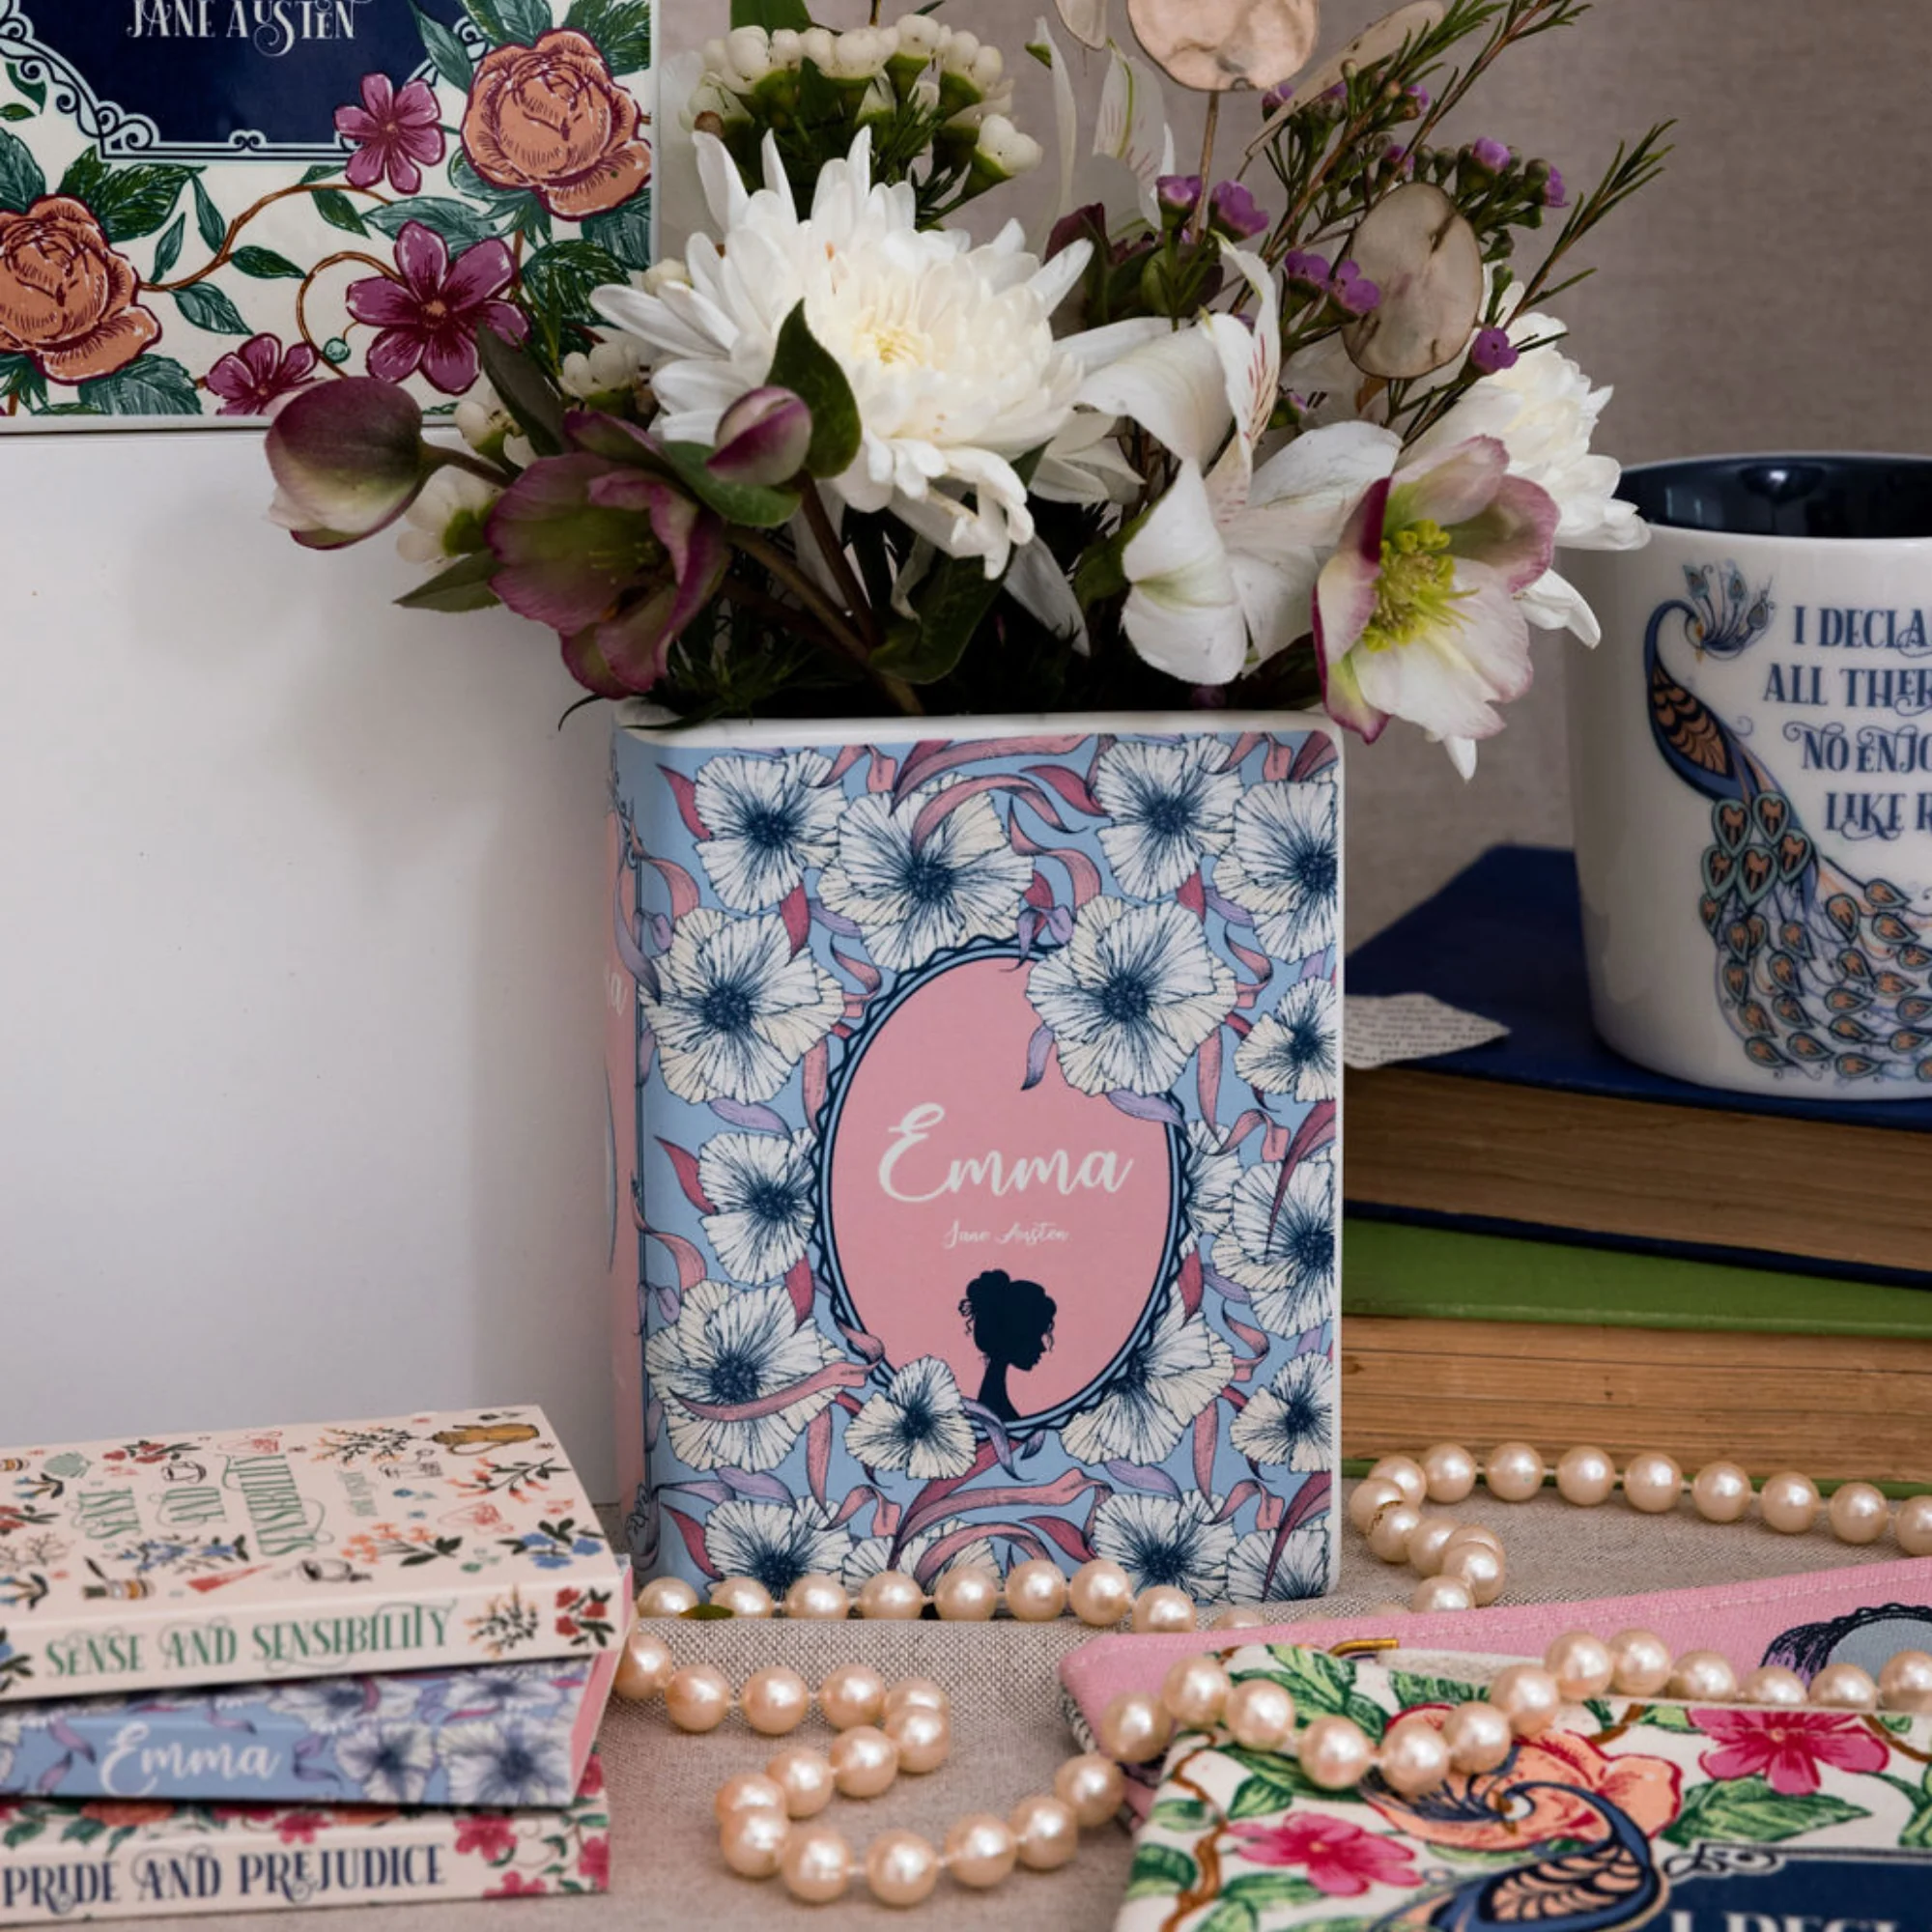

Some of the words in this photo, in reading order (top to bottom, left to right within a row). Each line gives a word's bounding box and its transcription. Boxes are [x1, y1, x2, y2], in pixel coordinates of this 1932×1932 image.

[127, 0, 215, 38] JANE
[226, 0, 357, 57] AUSTEN
[1793, 605, 1805, 645] I
[1763, 663, 1828, 705] ALL
[1782, 721, 1849, 772] NO
[1825, 792, 1907, 841] LIKE
[878, 1103, 1134, 1203] Emma
[941, 1218, 991, 1249] Jane
[994, 1221, 1070, 1246] Austen
[65, 1487, 142, 1539] SENSE
[148, 1487, 227, 1528] AND
[214, 1454, 335, 1557] SENSIBILITY
[45, 1627, 145, 1678] SENSE
[157, 1615, 238, 1670] AND
[252, 1598, 459, 1672] SENSIBILITY
[99, 1721, 281, 1796] Emma
[3, 1861, 121, 1916] PRIDE
[130, 1842, 222, 1903] AND
[239, 1843, 446, 1903] PREJUDICE
